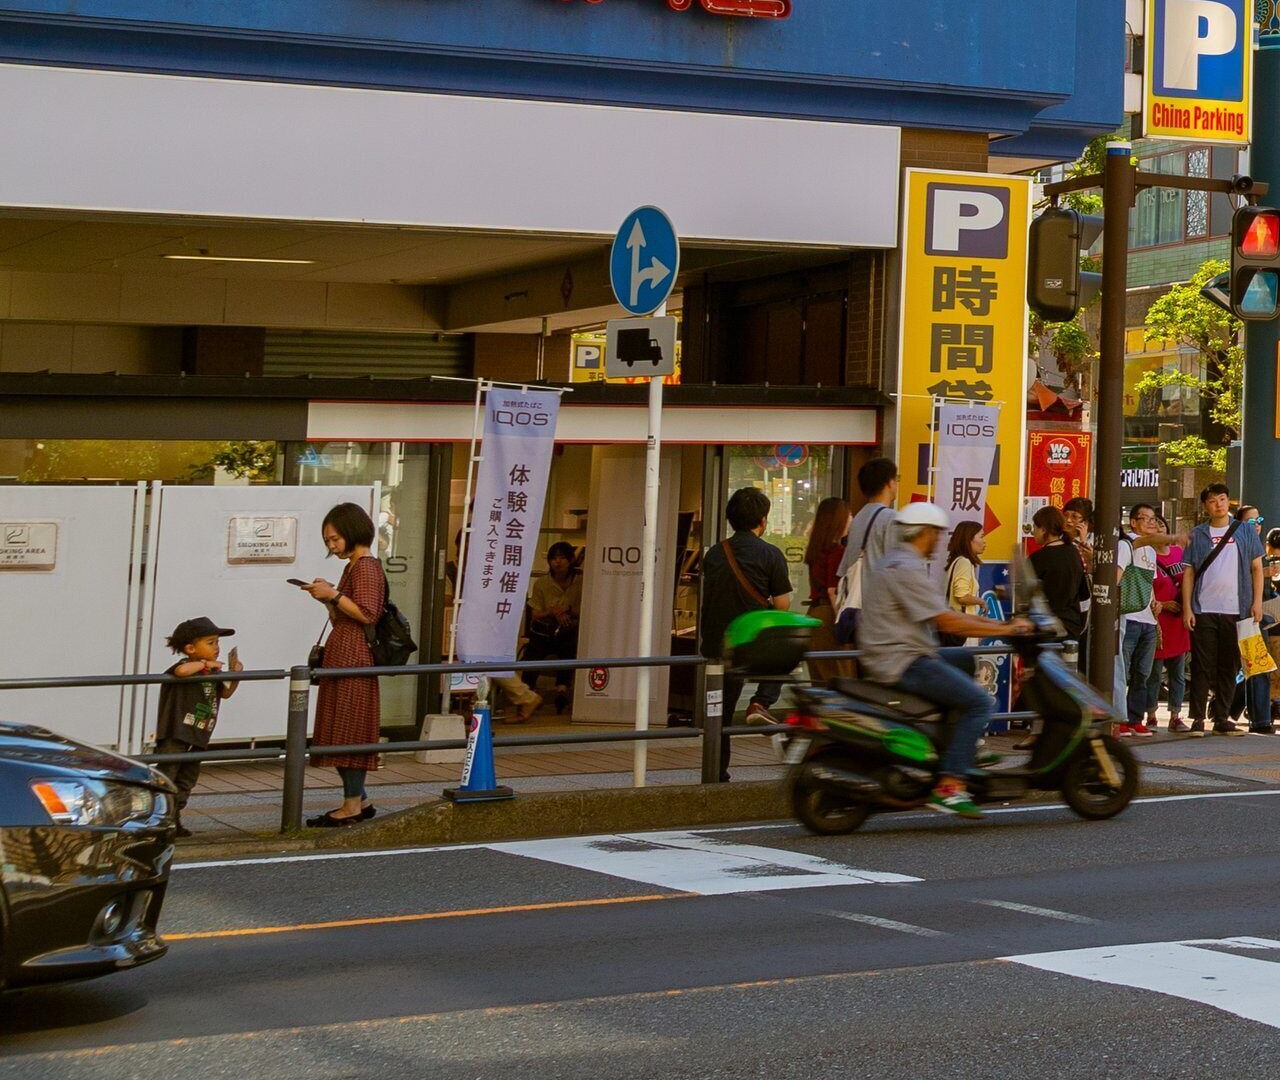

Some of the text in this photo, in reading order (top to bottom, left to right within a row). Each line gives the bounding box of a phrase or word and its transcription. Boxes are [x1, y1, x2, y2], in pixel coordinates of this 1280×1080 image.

[1152, 102, 1244, 138] China Parking
[931, 189, 1004, 252] P
[502, 400, 543, 409] 加熱式たばこ
[492, 410, 551, 426] IQOS
[947, 424, 995, 438] IQOS
[1050, 443, 1070, 454] We
[480, 498, 502, 590] ご購入できます
[495, 464, 530, 620] 体験会開催中
